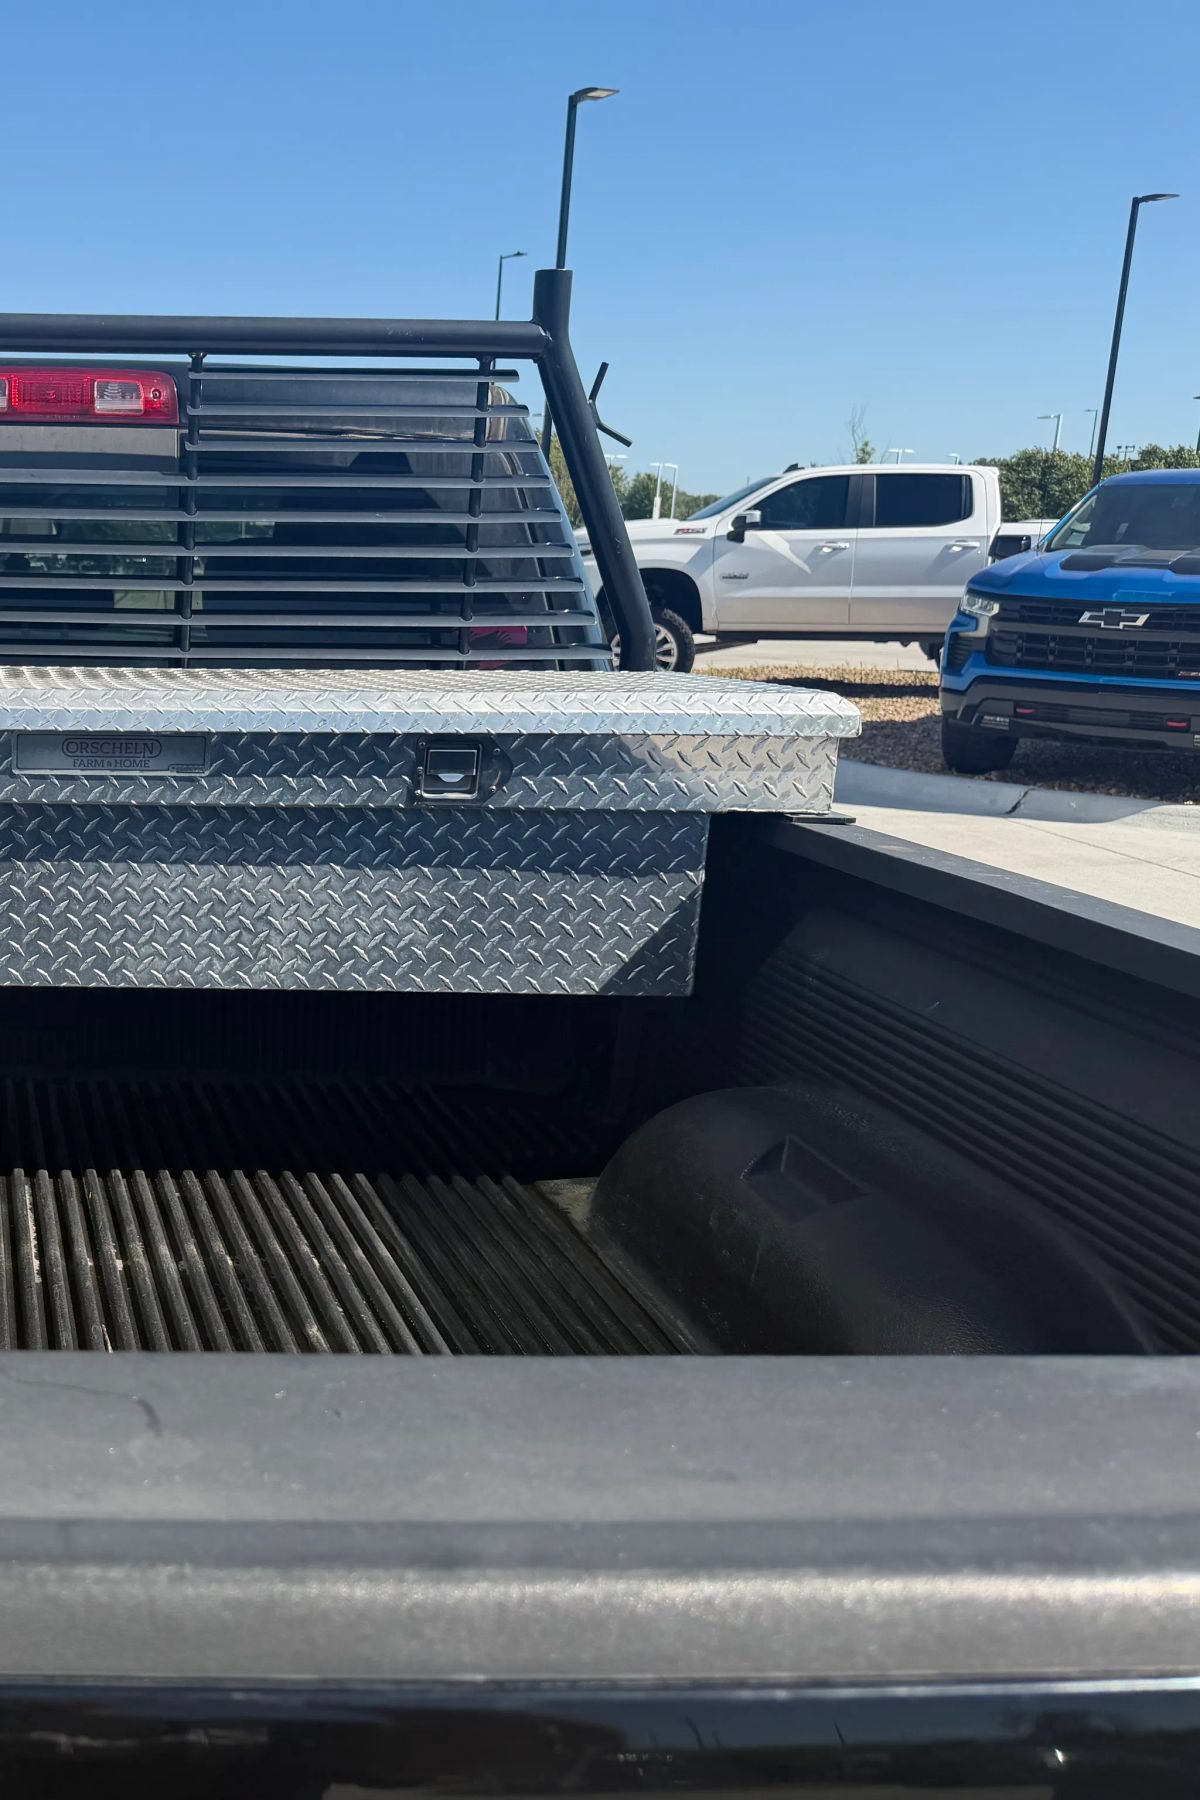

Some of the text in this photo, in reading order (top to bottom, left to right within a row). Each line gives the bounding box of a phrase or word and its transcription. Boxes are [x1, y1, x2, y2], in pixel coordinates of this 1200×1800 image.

[66, 741, 155, 757] ORSCHELN
[73, 759, 105, 767] FARM
[115, 759, 150, 768] HOME
